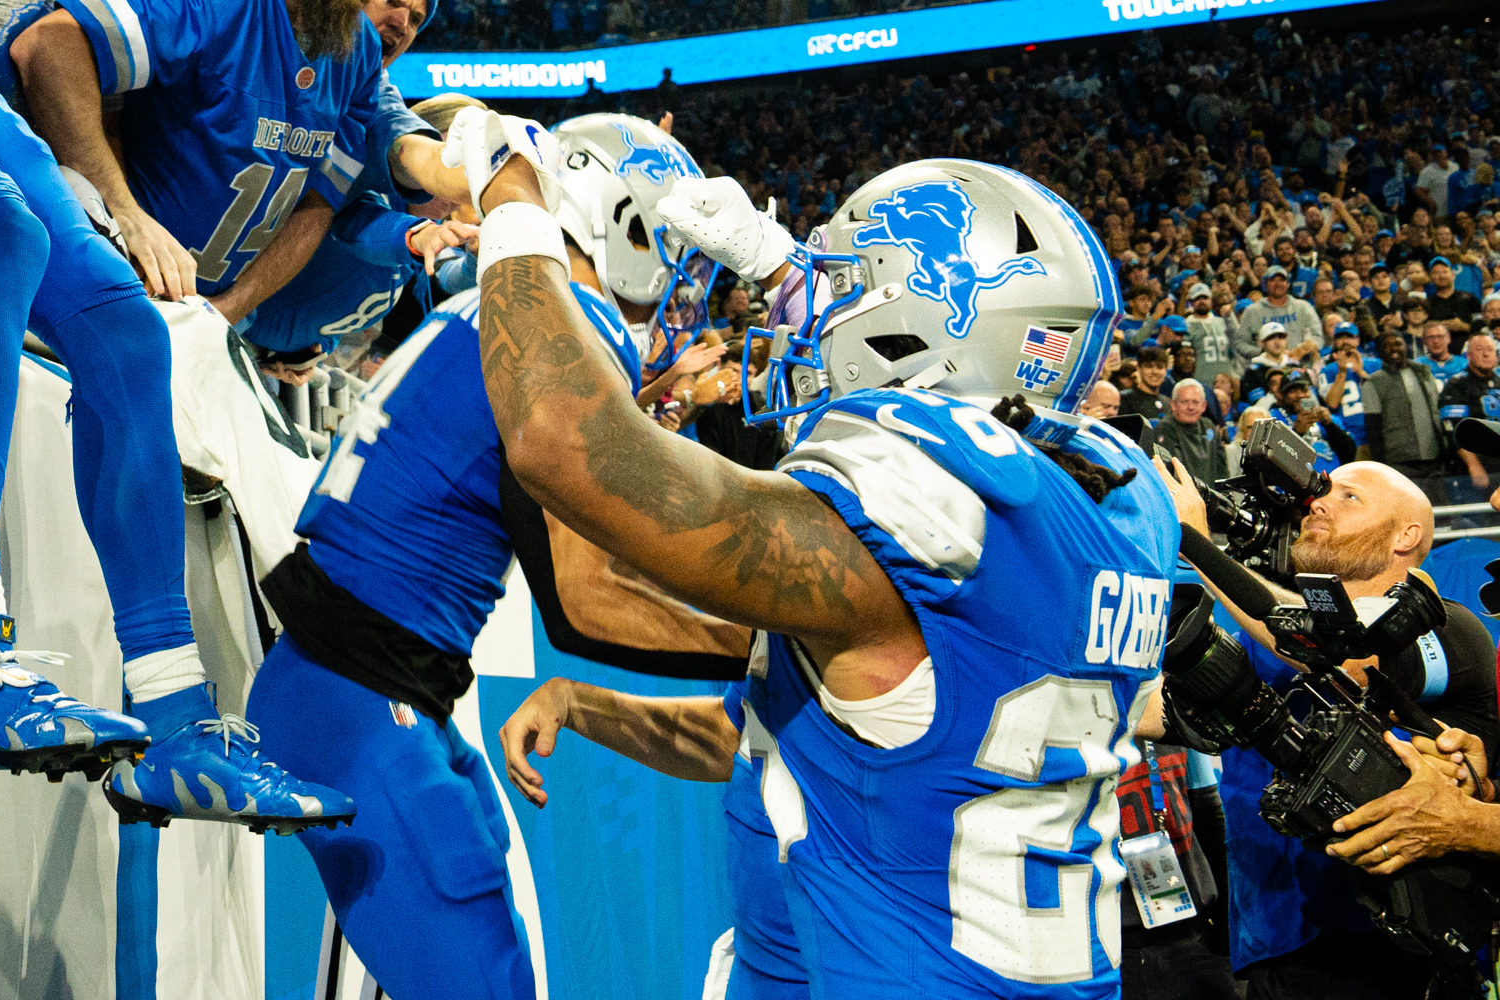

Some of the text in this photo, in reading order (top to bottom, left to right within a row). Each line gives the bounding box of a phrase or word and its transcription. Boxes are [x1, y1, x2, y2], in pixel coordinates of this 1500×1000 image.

[836, 27, 898, 53] CFCU
[427, 59, 606, 88] TOUCHDOWN
[253, 117, 335, 158] DETROIT
[189, 162, 310, 283] 14
[1015, 360, 1063, 388] WCF
[1277, 439, 1299, 460] AMIRA
[1309, 601, 1339, 613] SPORTS
[1312, 588, 1334, 602] CBS
[1142, 903, 1155, 926] OPS
